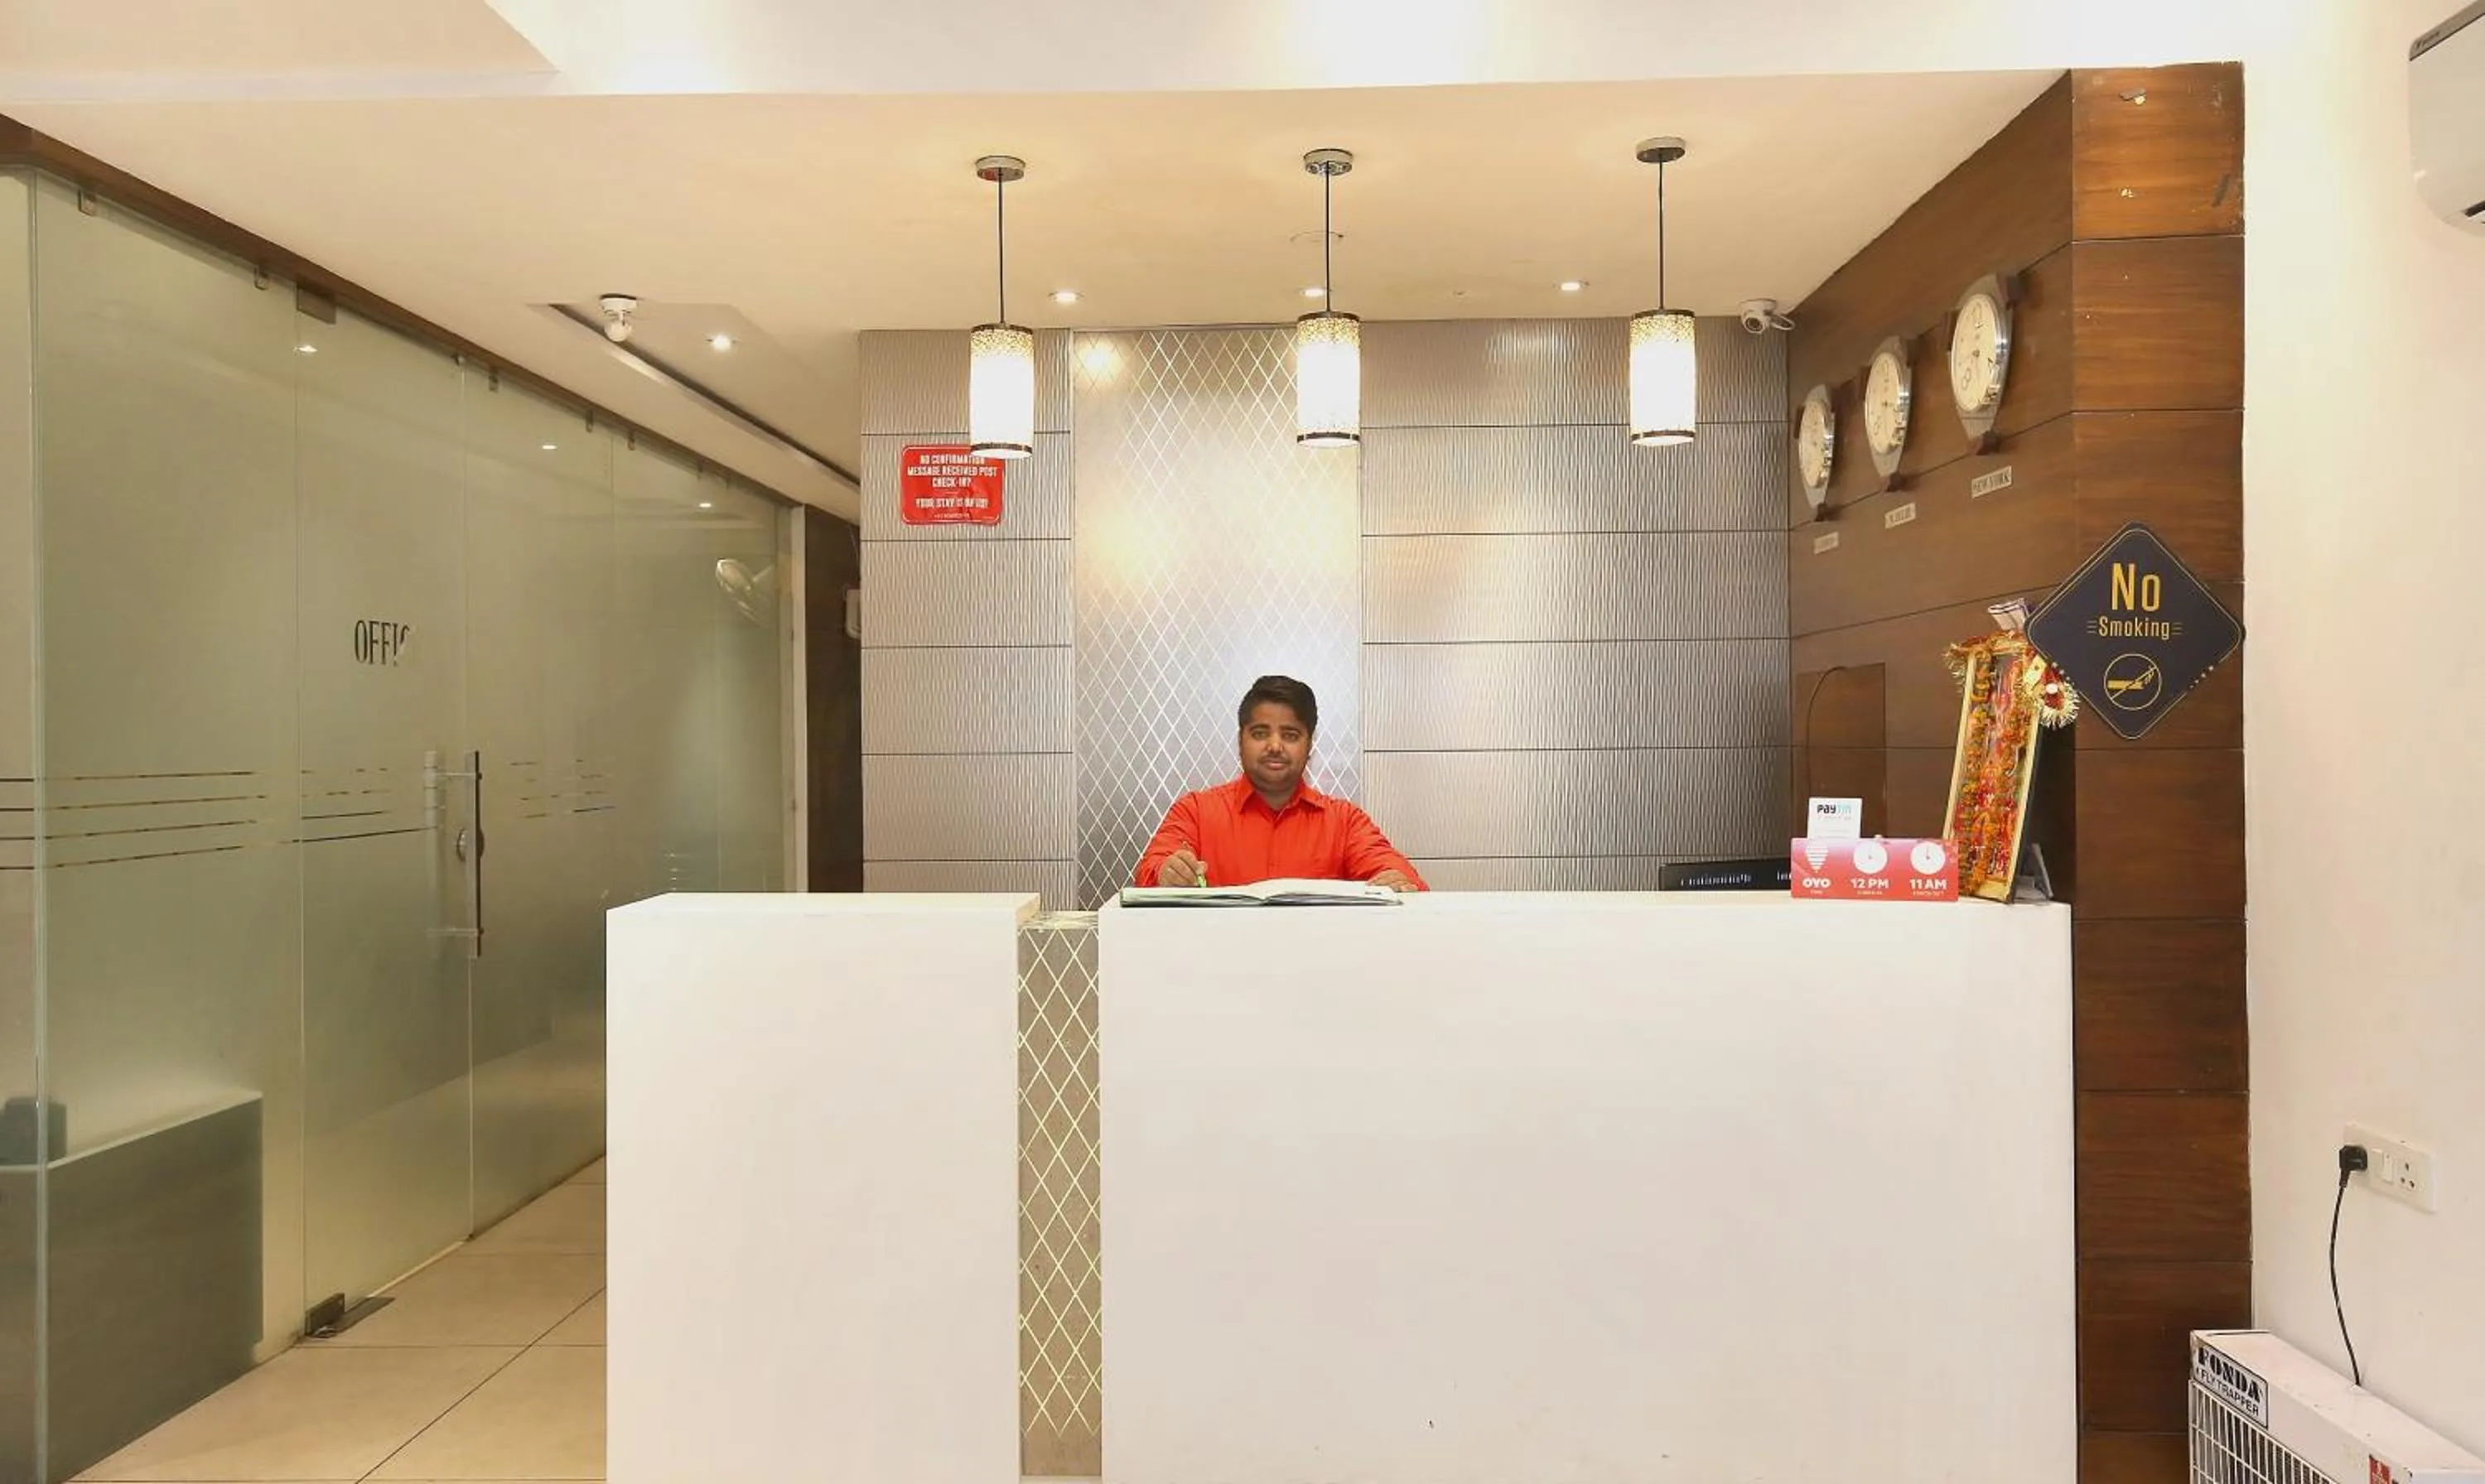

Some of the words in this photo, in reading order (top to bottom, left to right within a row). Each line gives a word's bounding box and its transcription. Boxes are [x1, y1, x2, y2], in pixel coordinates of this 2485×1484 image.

[907, 465, 940, 476] MESSAGE
[942, 465, 977, 476] RECEIVED
[978, 466, 996, 477] POST
[932, 477, 972, 488] CHECK-IN?
[2111, 562, 2161, 612] No
[2098, 615, 2170, 640] Smoking
[1802, 878, 1831, 889] OYO
[1851, 878, 1865, 889] 12
[1868, 879, 1889, 889] PM
[1909, 879, 1923, 889] 11
[1923, 879, 1947, 889] AM
[2198, 1347, 2264, 1403] FONDA
[2201, 1370, 2216, 1384] FLY
[2216, 1380, 2260, 1416] TRAPPER
